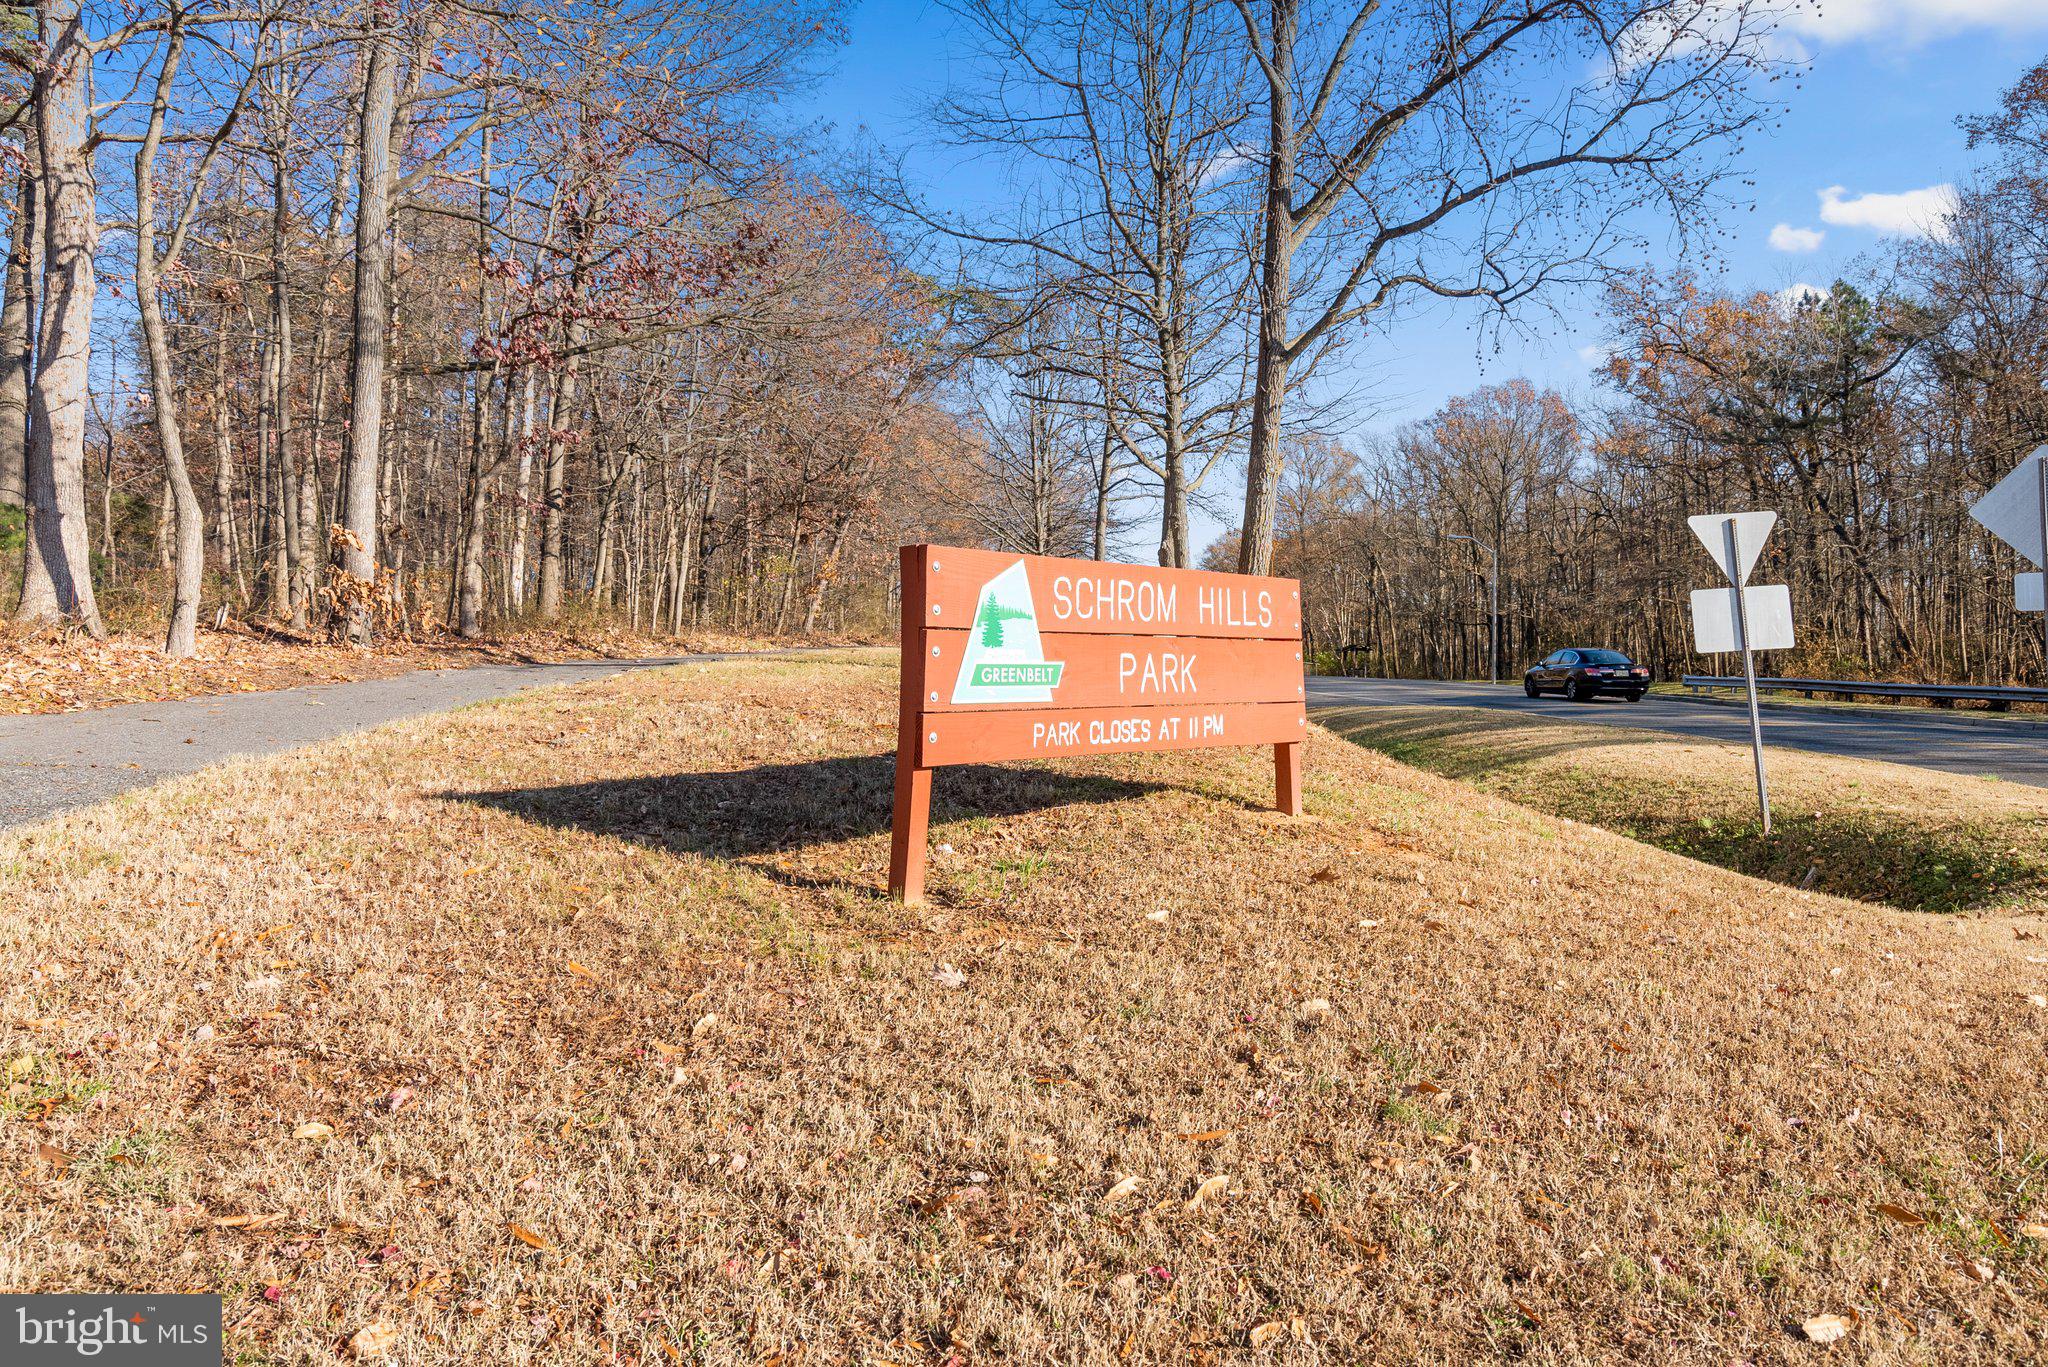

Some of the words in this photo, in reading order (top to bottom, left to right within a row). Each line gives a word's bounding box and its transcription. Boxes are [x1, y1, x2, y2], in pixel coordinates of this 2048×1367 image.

[1053, 576, 1176, 623] SCHROM
[1199, 587, 1272, 628] HILLS
[981, 667, 1054, 684] GREENBELT
[1119, 653, 1197, 693] PARK
[1033, 721, 1081, 748] PARK
[1089, 718, 1151, 744] CLOSES
[1157, 716, 1179, 740] AT
[1189, 716, 1199, 739] 11
[1203, 713, 1224, 738] PM
